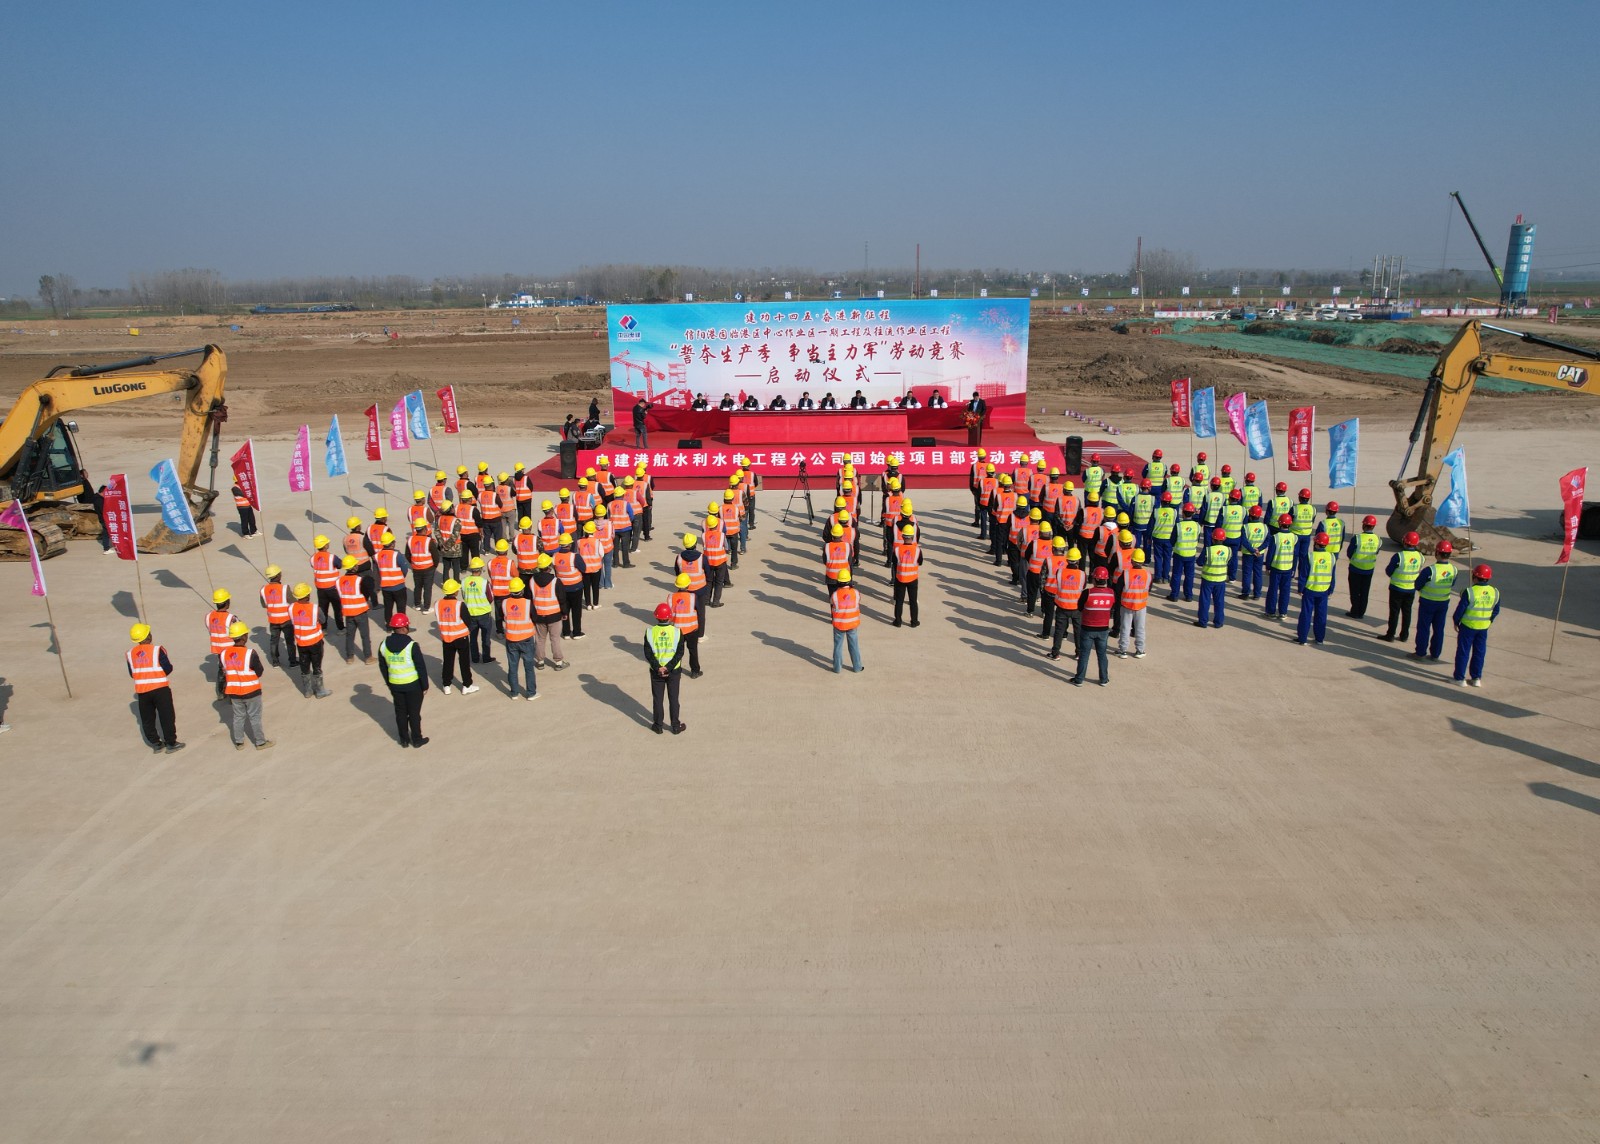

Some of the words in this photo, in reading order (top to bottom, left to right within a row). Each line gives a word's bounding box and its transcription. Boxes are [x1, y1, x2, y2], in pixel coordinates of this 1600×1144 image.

[1518, 235, 1532, 272] 中国电建
[766, 364, 871, 384] 启动仪式
[1557, 365, 1583, 383] CAT
